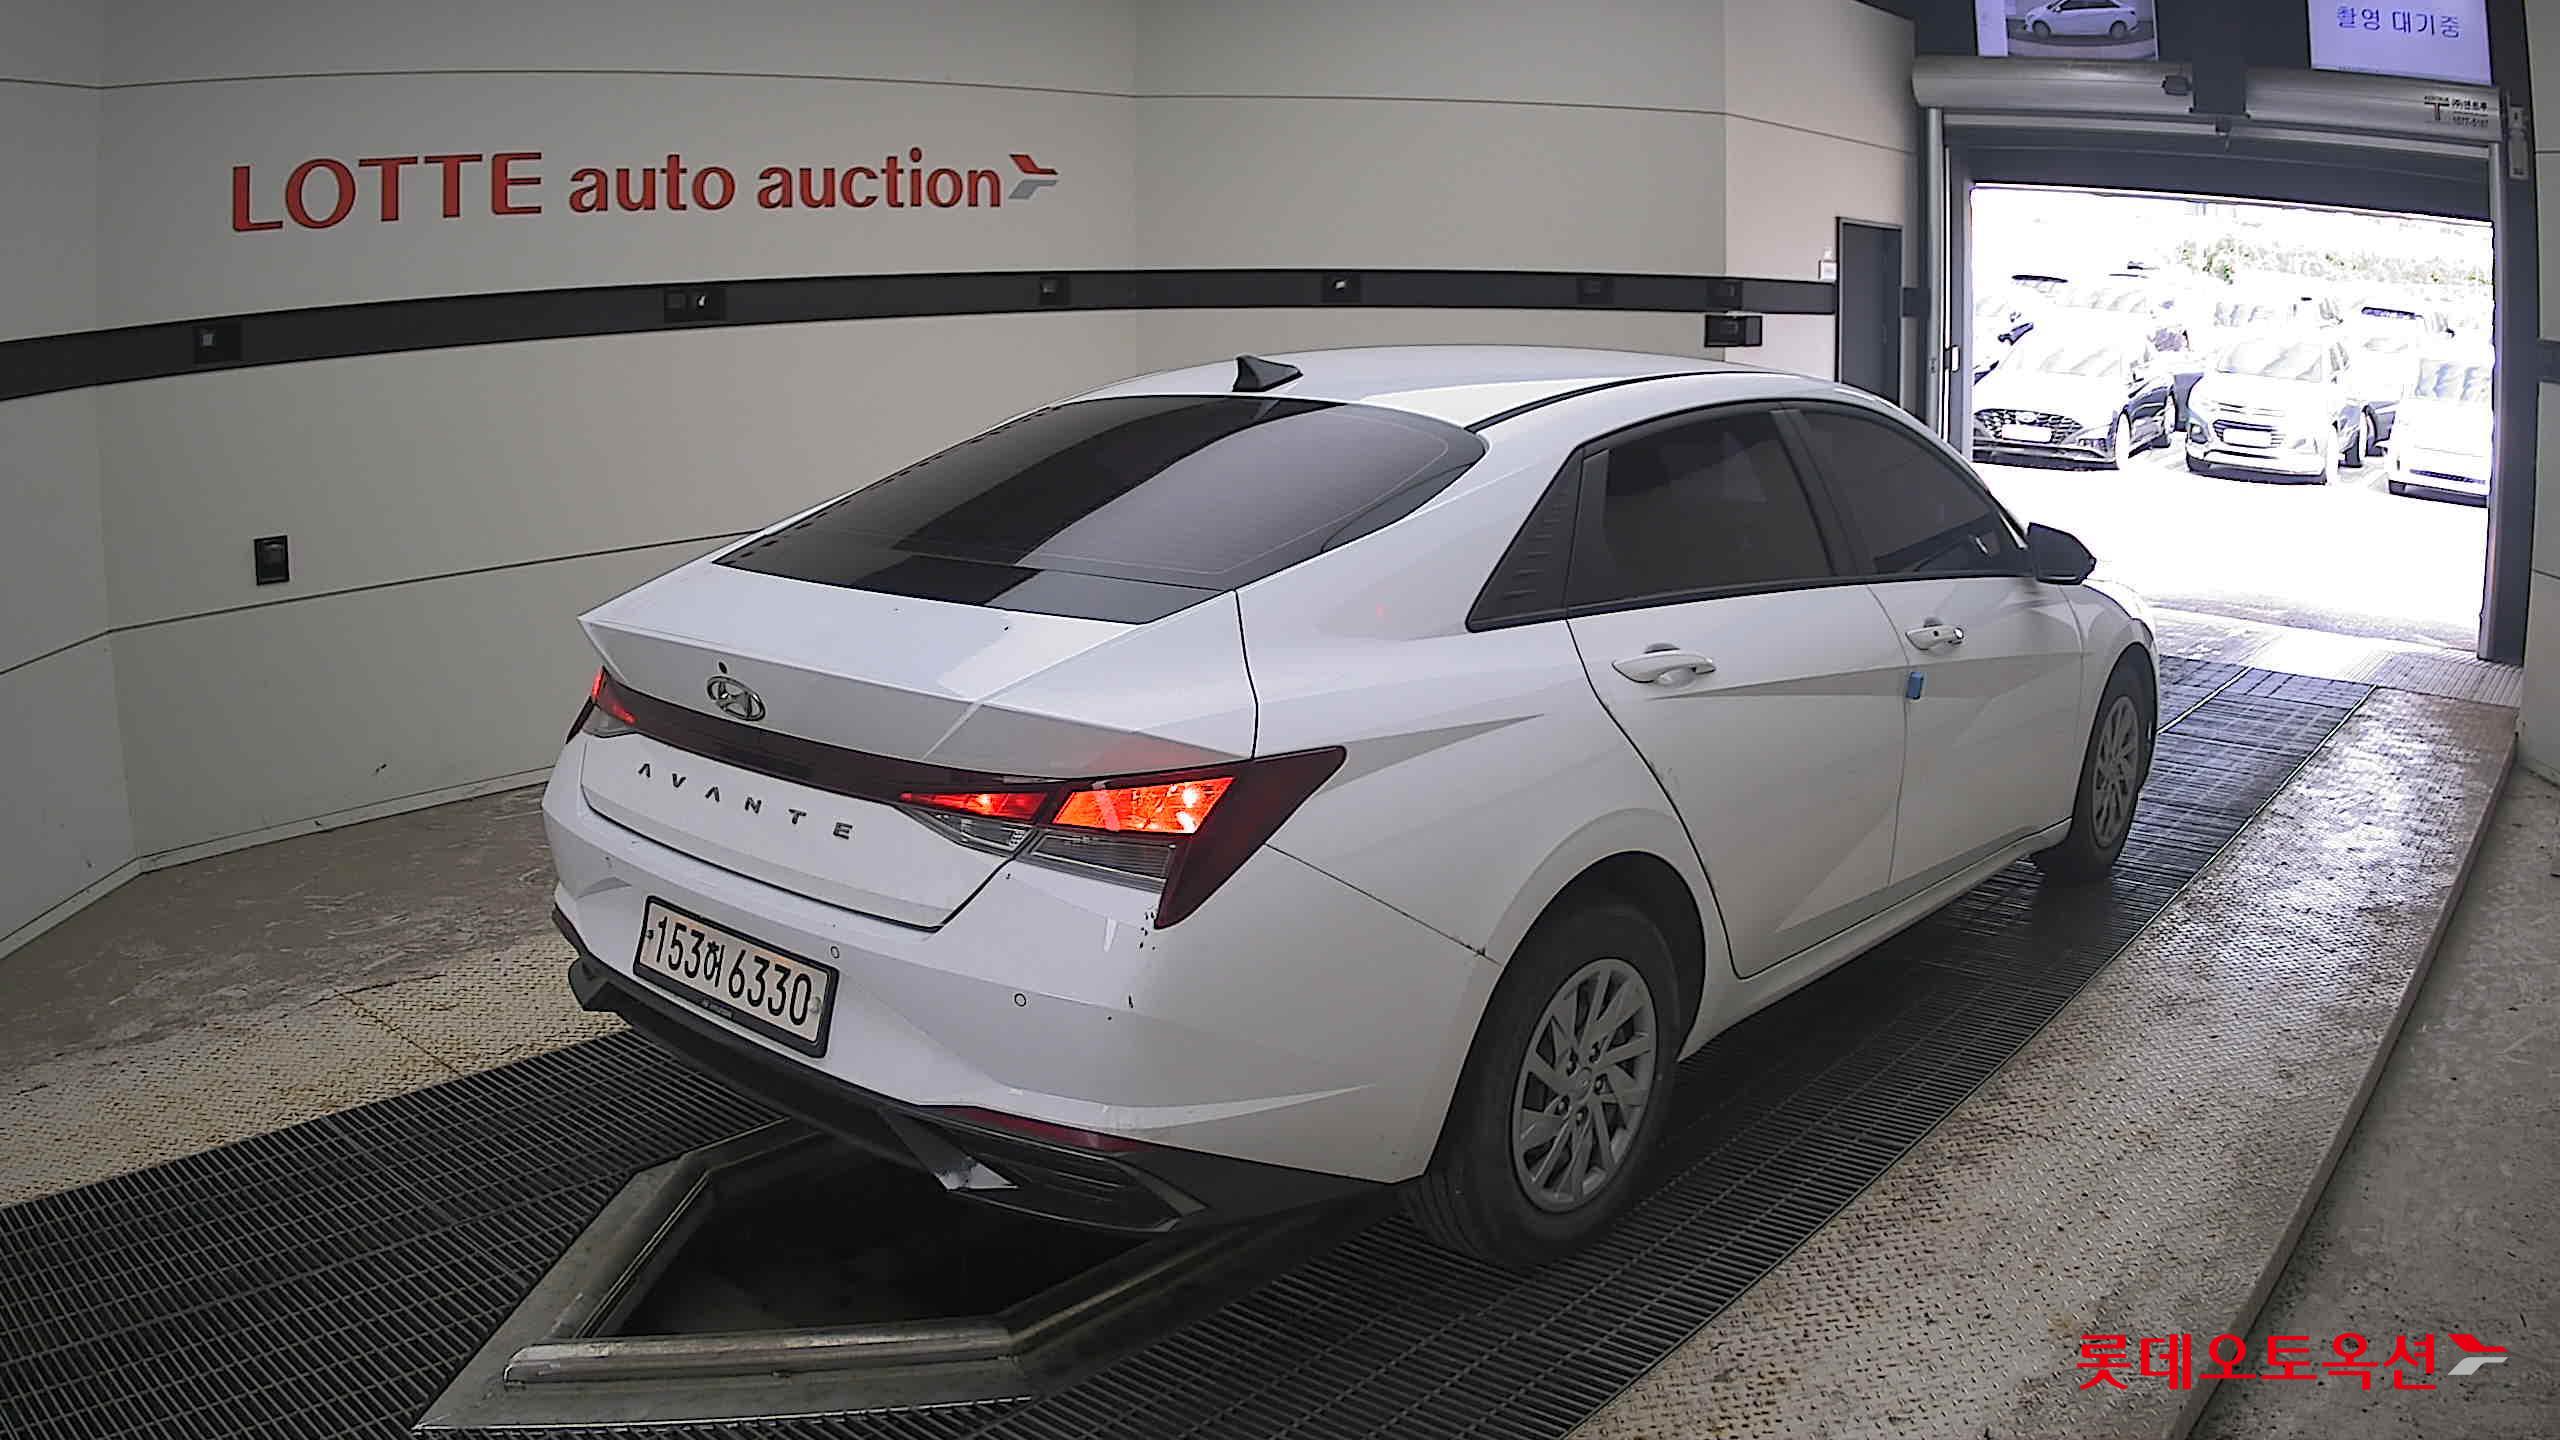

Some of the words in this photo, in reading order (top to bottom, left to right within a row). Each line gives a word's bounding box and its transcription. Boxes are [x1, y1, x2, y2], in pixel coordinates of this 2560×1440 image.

[2337, 6, 2380, 31] 촬영
[2392, 11, 2459, 39] 대기중
[232, 152, 542, 233] LOTTE
[569, 154, 736, 213] auto
[757, 147, 1001, 209] auction
[638, 763, 853, 840] AVANTE
